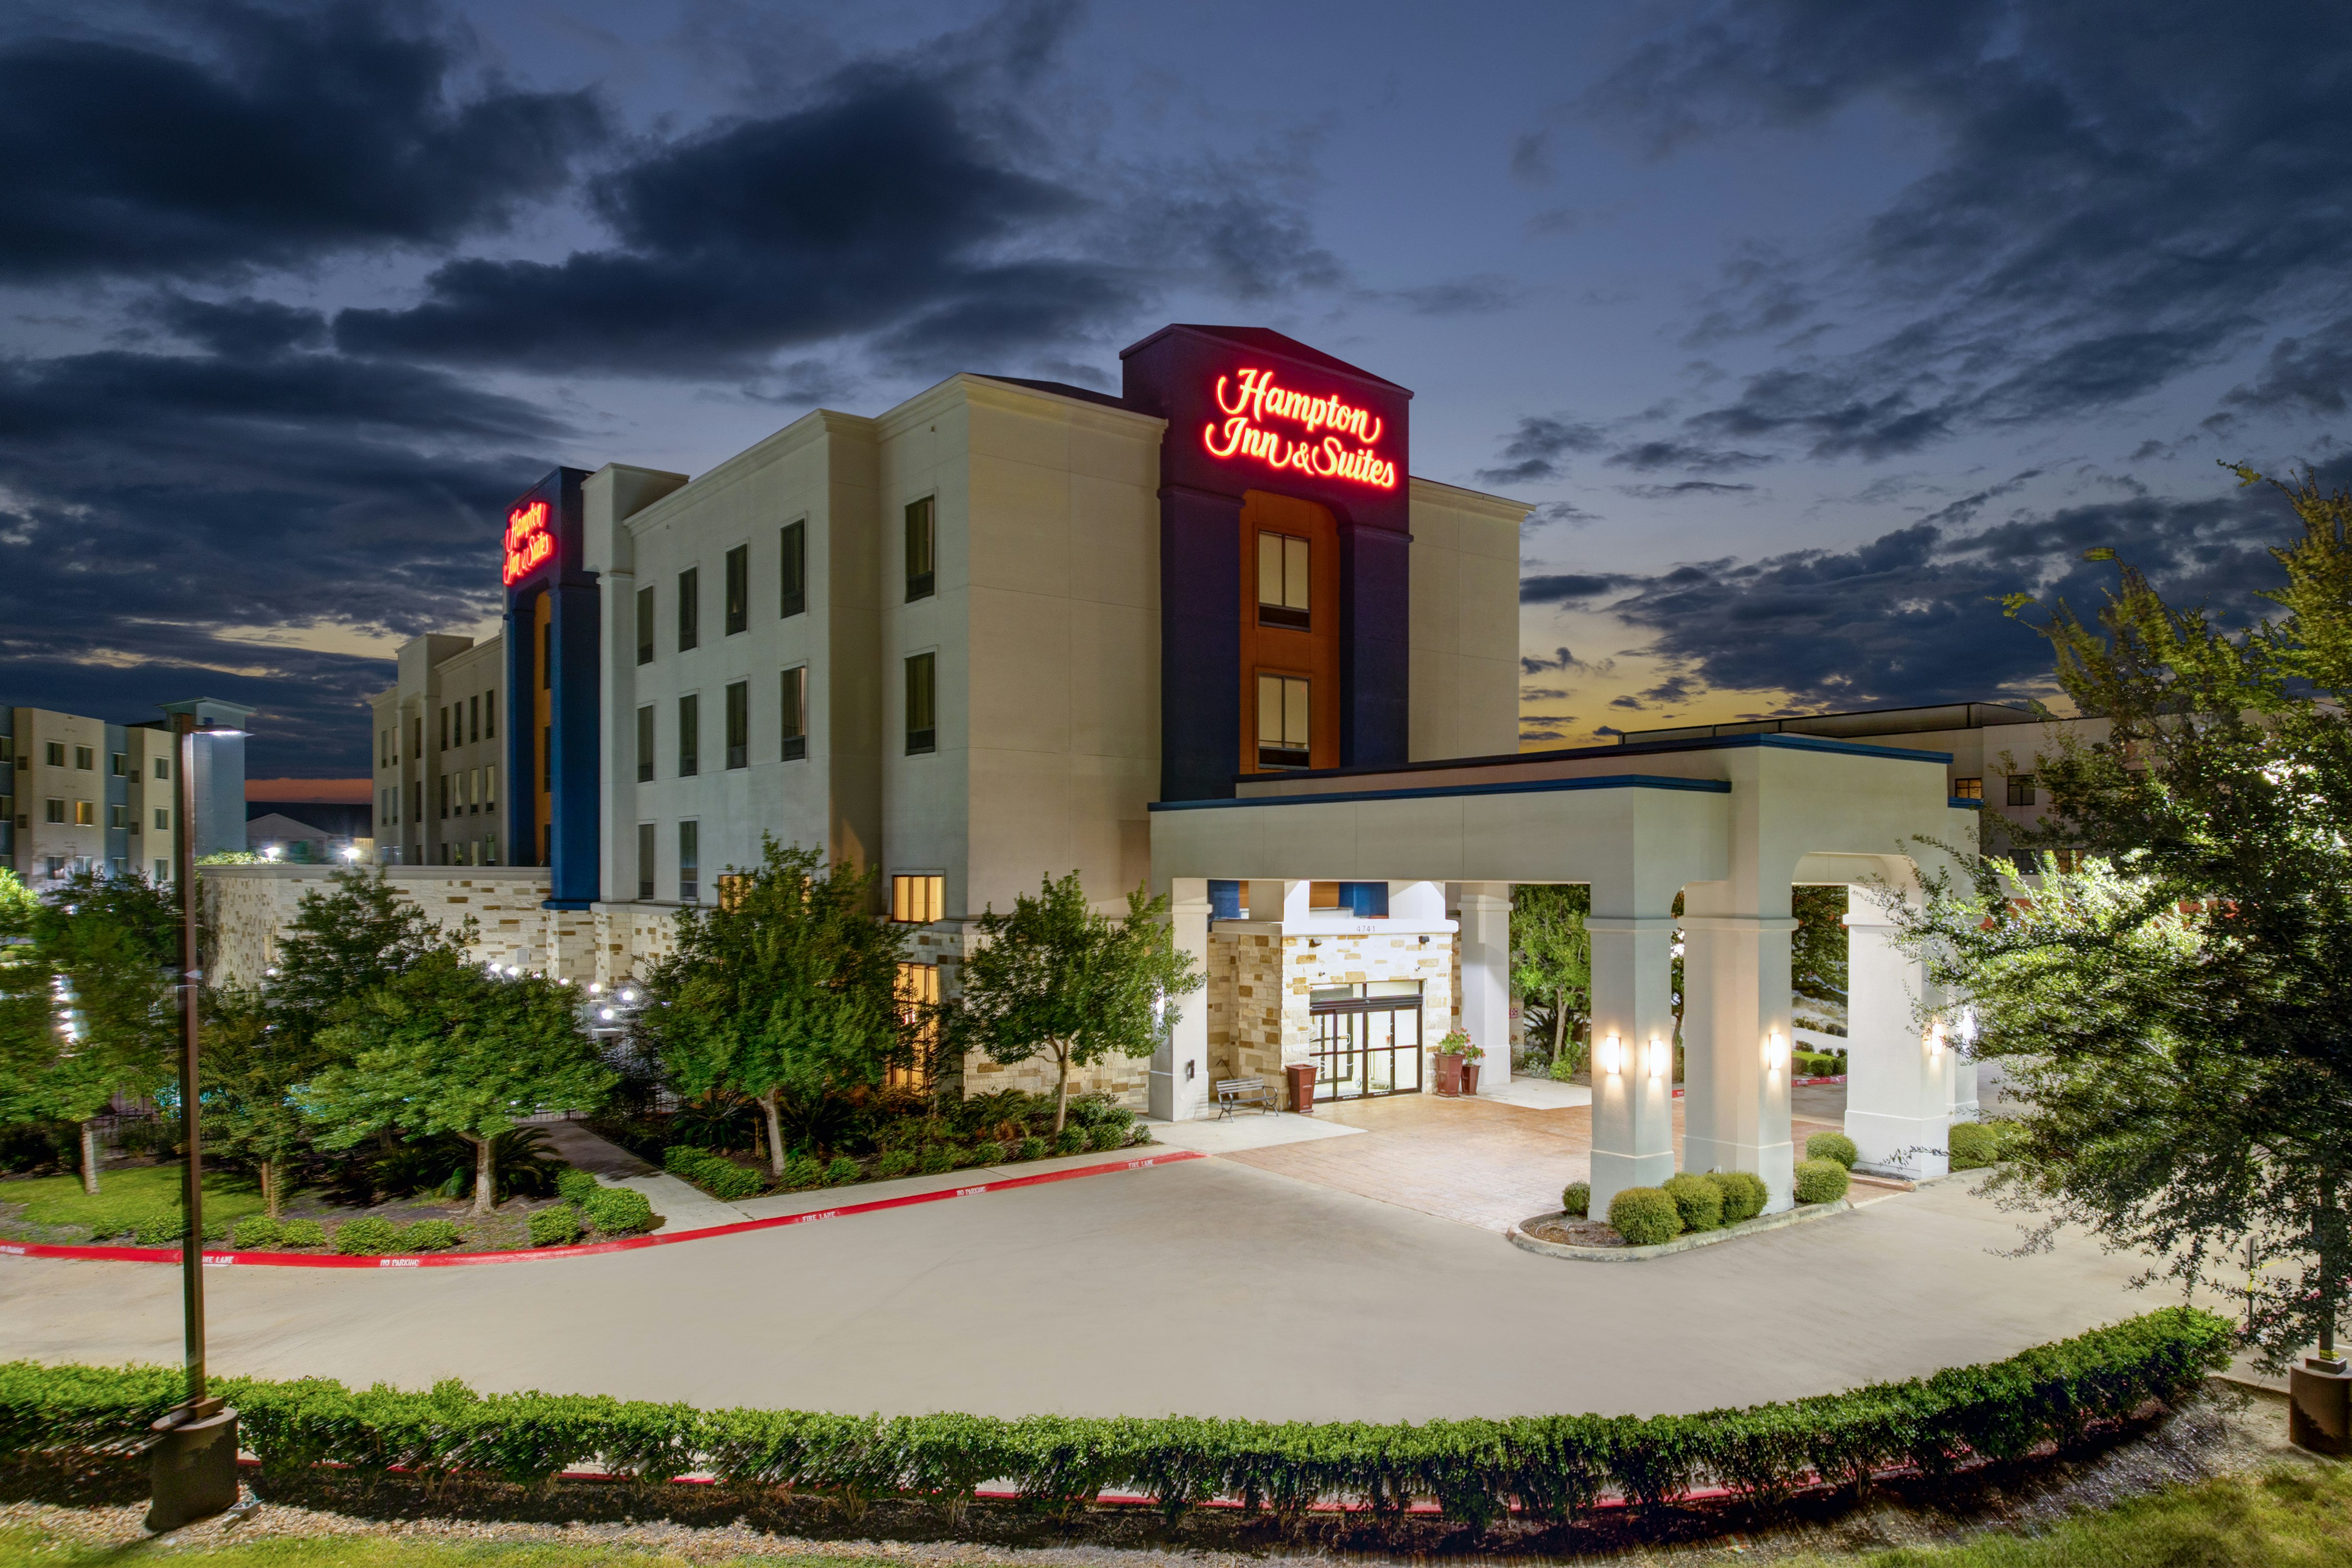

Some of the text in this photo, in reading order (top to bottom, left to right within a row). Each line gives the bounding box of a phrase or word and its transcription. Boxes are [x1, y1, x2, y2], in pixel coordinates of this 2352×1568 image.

[1216, 368, 1381, 443] Hampton
[1205, 416, 1396, 488] Inn & Suites
[1141, 1159, 1154, 1167] LANE
[965, 1186, 986, 1195] PARKING
